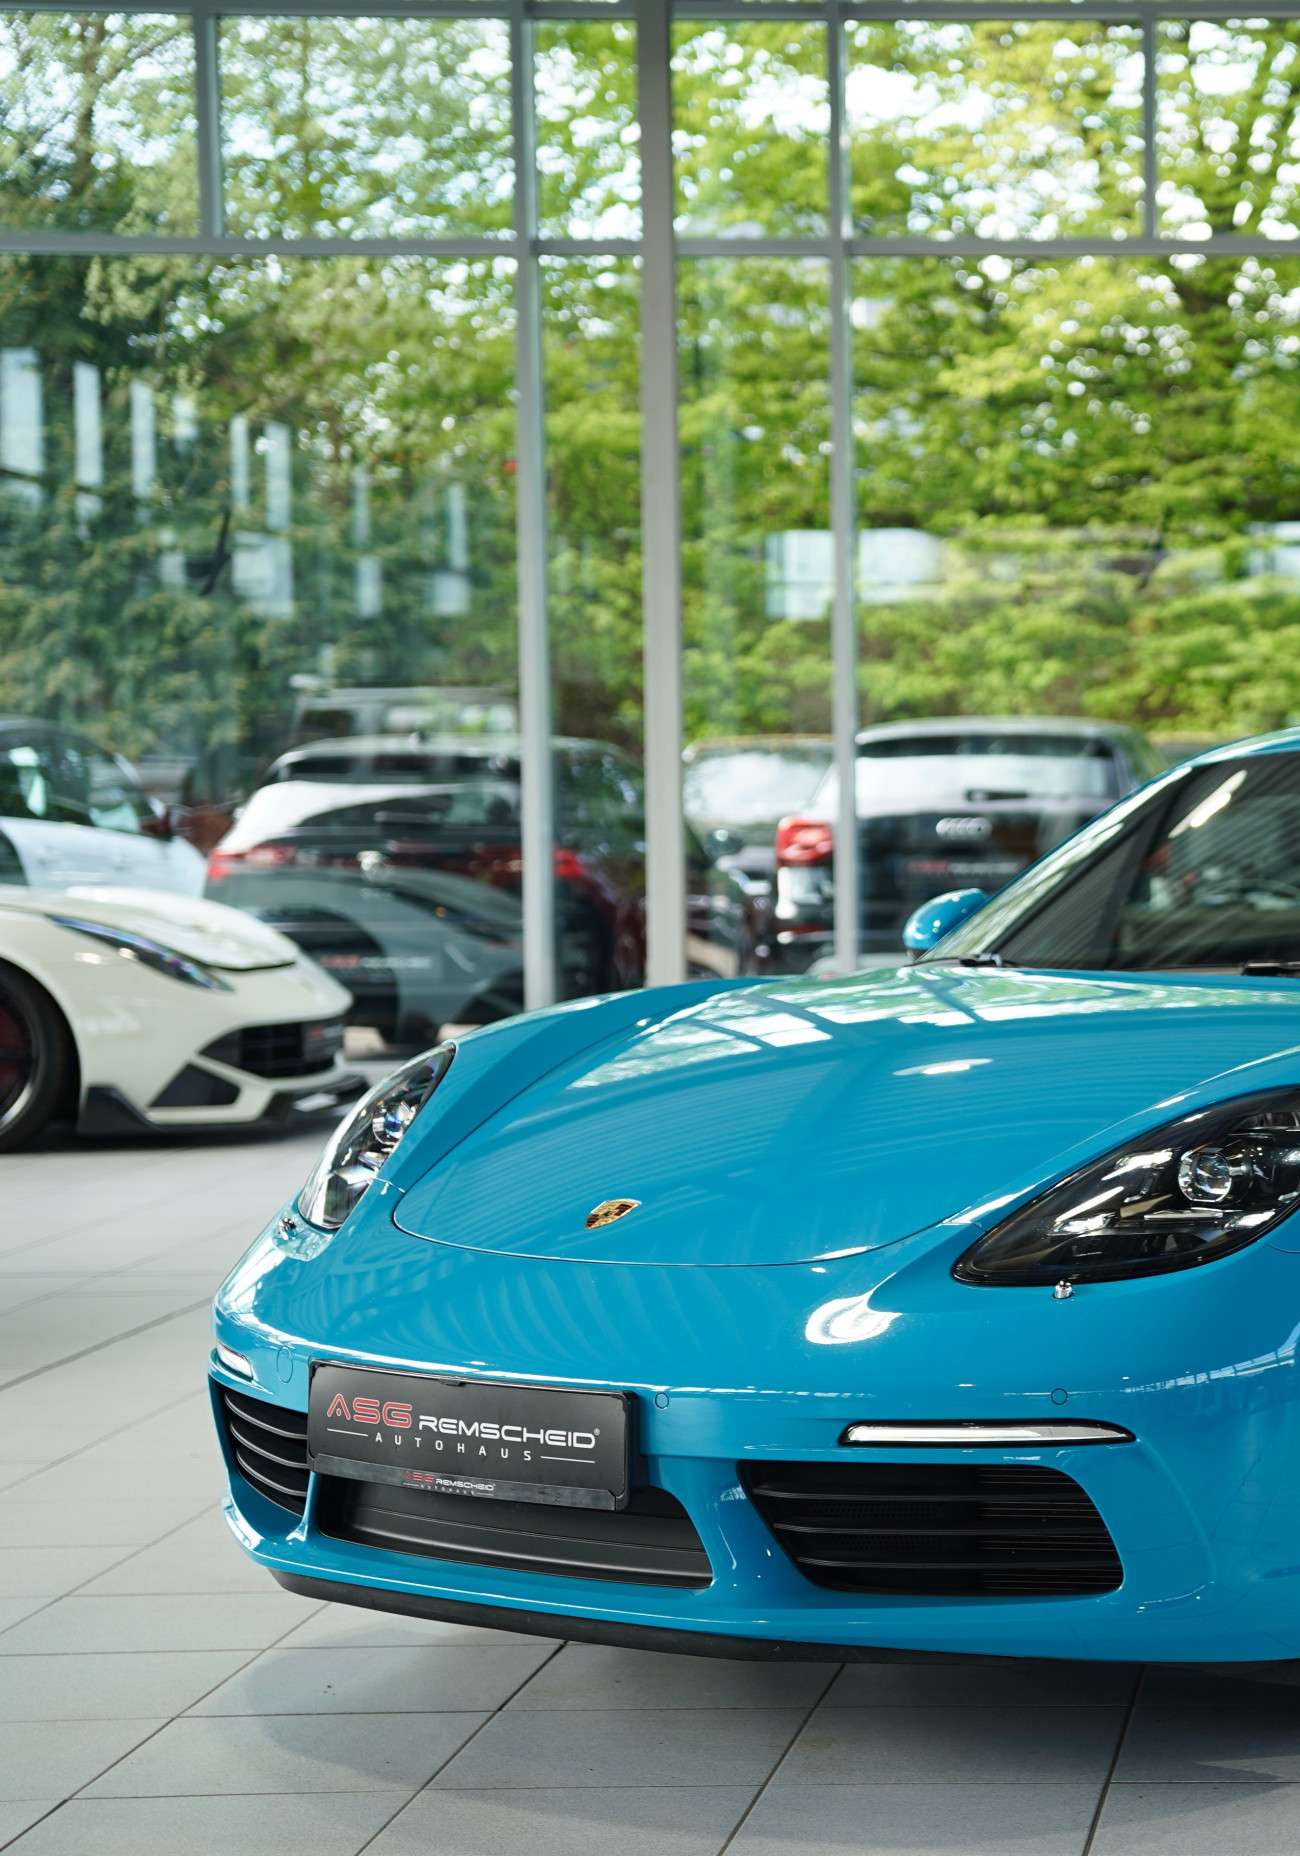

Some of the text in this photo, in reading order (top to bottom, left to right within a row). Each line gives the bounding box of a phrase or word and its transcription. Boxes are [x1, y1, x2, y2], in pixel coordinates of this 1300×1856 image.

[326, 1392, 596, 1449] ASG REMSCHEID
[375, 1432, 532, 1461] AUTOHAUS
